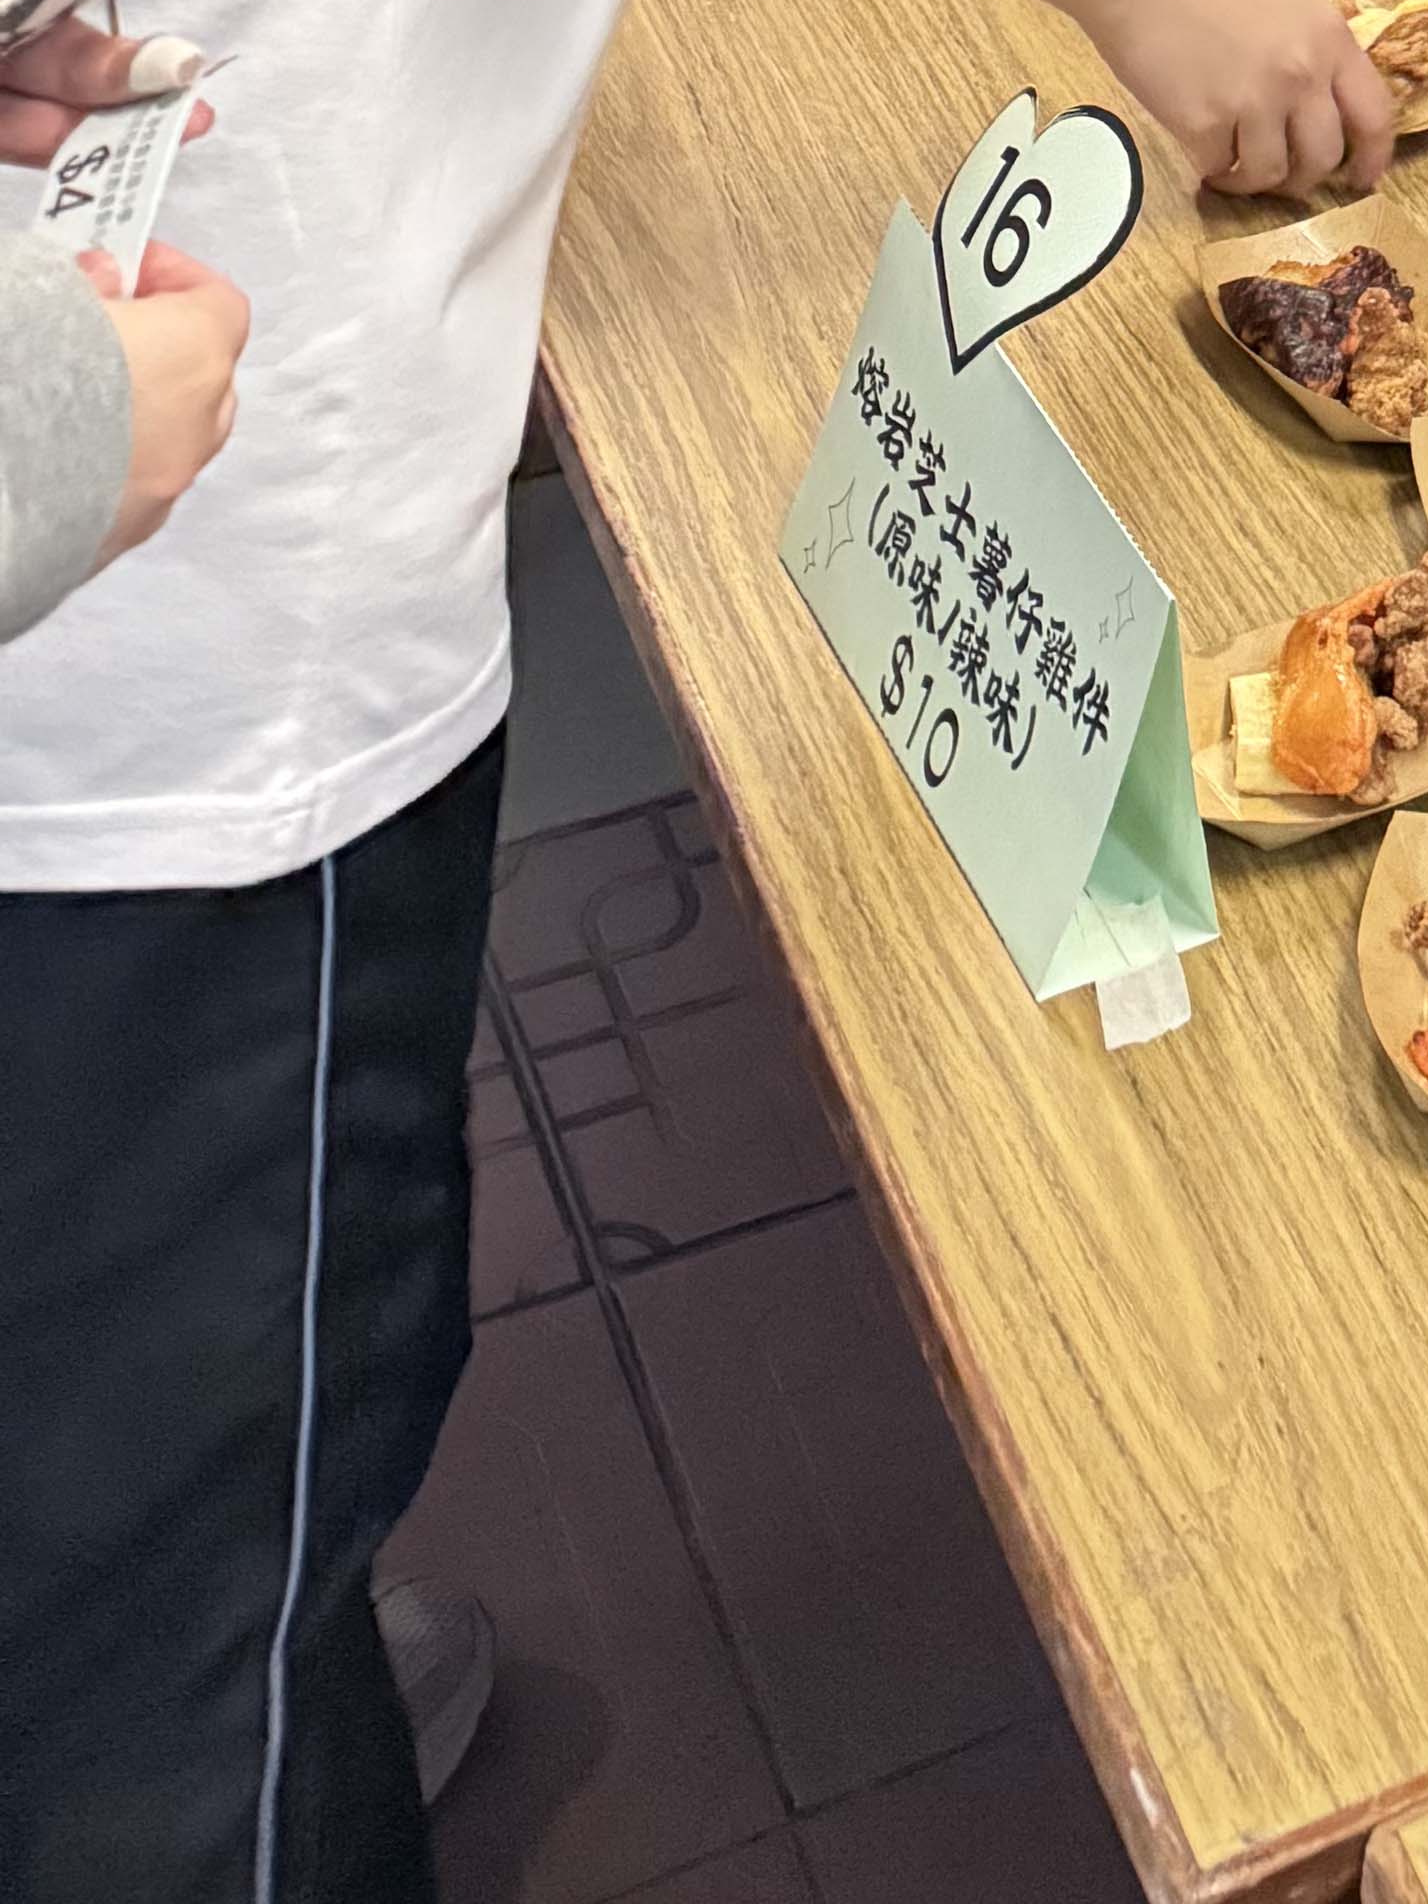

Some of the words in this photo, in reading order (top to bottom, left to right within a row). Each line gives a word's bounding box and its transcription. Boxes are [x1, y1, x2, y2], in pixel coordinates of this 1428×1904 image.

[44, 145, 111, 220] $4
[960, 144, 1053, 289] 16
[851, 345, 1111, 757] 熔岩芝士薯仔雞件
[879, 633, 961, 789] $10
